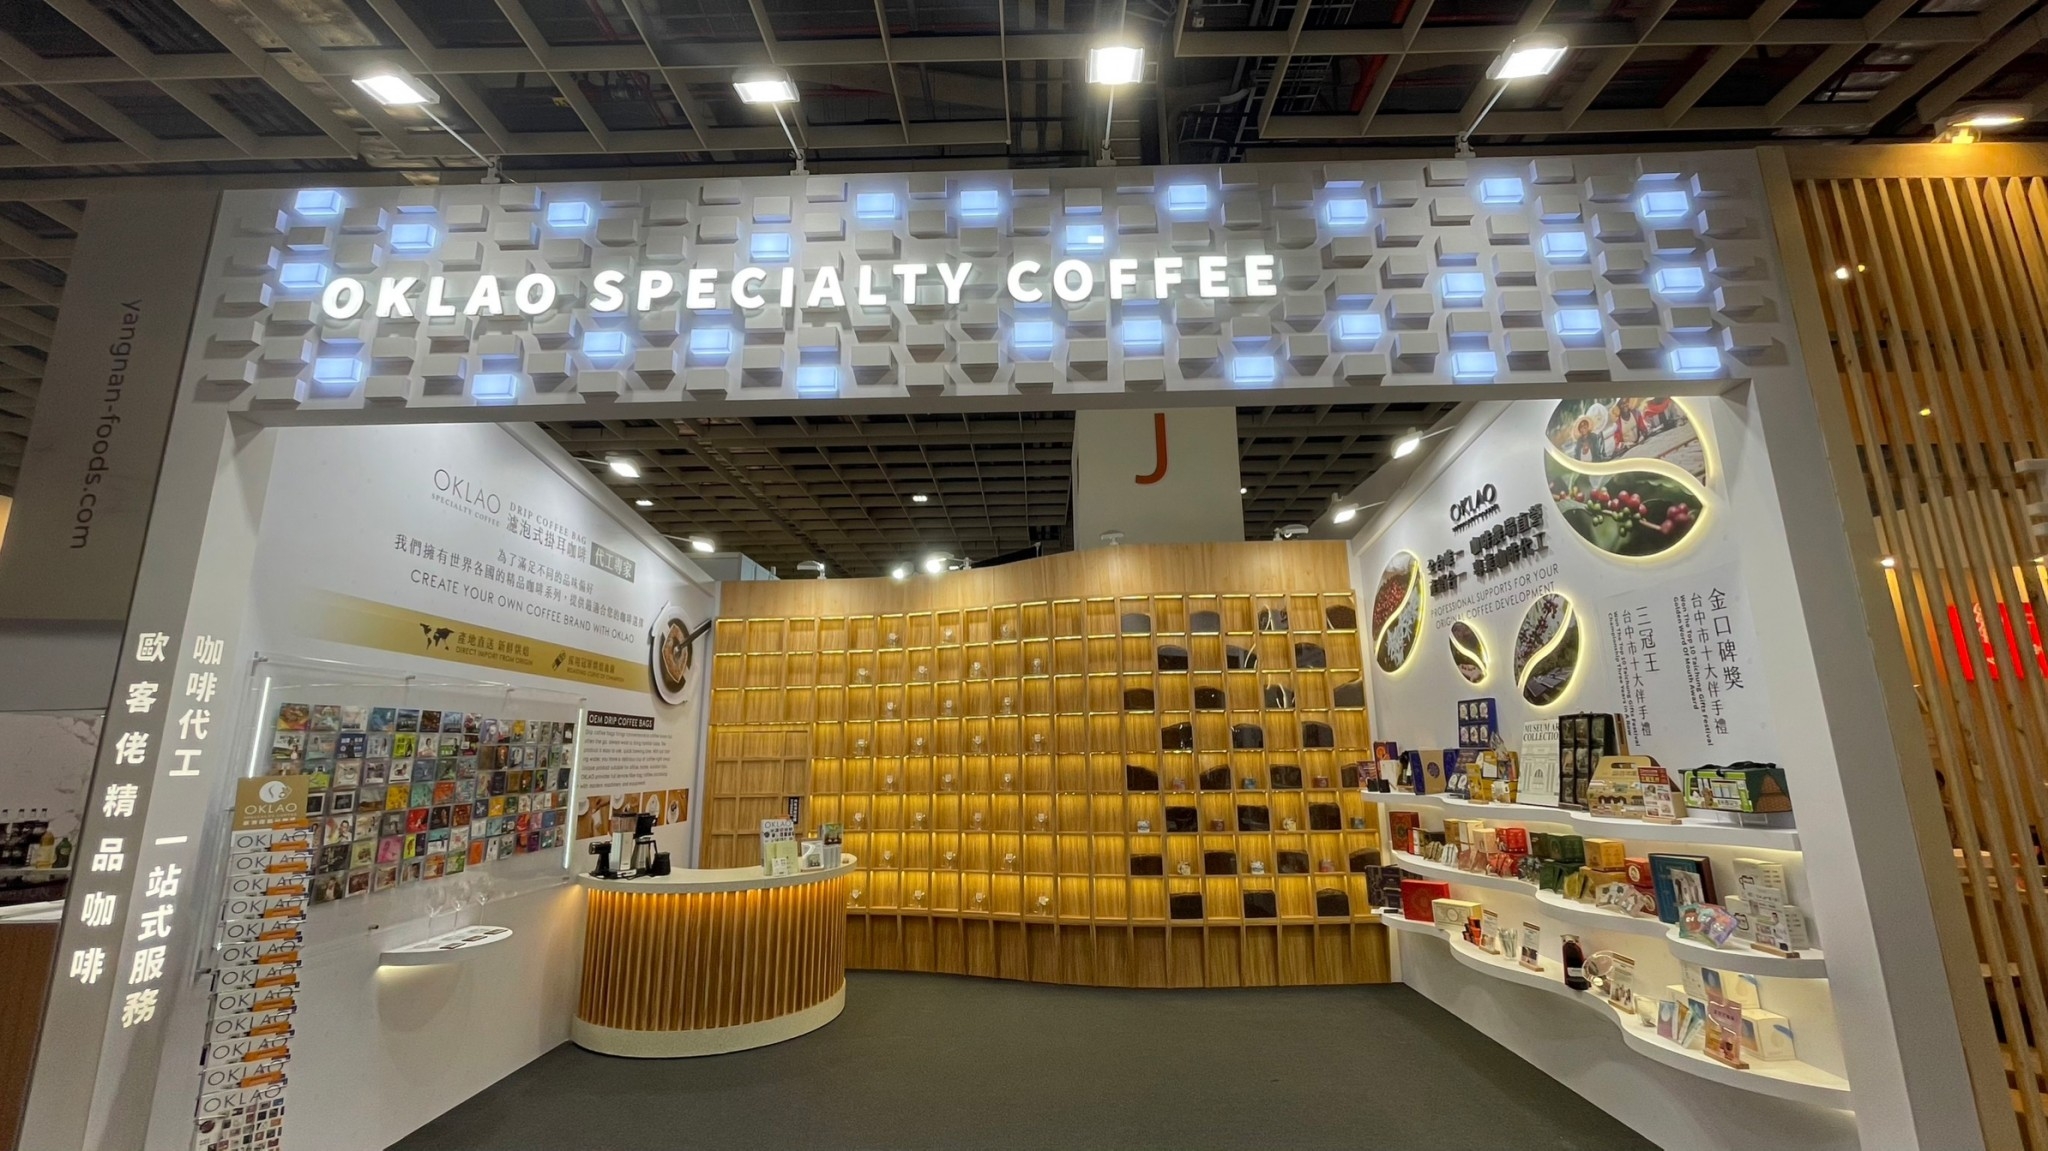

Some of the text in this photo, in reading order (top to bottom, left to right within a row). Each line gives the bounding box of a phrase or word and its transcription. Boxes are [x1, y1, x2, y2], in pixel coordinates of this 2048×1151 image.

[321, 254, 1277, 320] OKLAO SPECIALTY COFFEE
[69, 298, 143, 551] yangnan-foods.com
[1135, 412, 1168, 485] J
[431, 492, 501, 528] SPECIALTY COFFEE
[434, 469, 501, 514] OKLAO
[1451, 484, 1498, 522] OKLAO
[505, 512, 587, 563] 濾泡式掛耳咖啡
[509, 501, 587, 545] DRIP COFFEE BAG
[593, 548, 633, 580] 代工專家
[410, 568, 634, 645] CREATE YOUR OWN COFFEE BRAND WITH OKLAO
[1430, 562, 1560, 619] PROFESSIONAL SUPPORTS FOR YOUR
[1466, 603, 1494, 620] COFFEE
[1495, 582, 1556, 609] DEVELOPMENT
[1679, 594, 1687, 612] Won
[1608, 612, 1620, 663] Championship
[1635, 606, 1661, 673] 三冠王
[1673, 596, 1699, 710] Golden Word Of Mouth Award
[1689, 645, 1696, 655] 10
[1707, 587, 1745, 691] 金口碑獎
[1620, 656, 1627, 665] 10
[1622, 608, 1652, 737] 台中市十大伴手禮
[1690, 592, 1729, 736] 台中市十大伴手禮
[1692, 656, 1702, 693] Taichung
[1622, 666, 1632, 699] Taichung
[588, 714, 653, 729] OEM DRIP COFFEE BAGS
[1698, 693, 1706, 713] Gifts
[1522, 731, 1559, 742] COLLECTIO
[1524, 722, 1550, 733] MUSEUM
[1631, 718, 1641, 747] Festival
[1702, 714, 1714, 747] Festival
[69, 630, 170, 986] 歐客佬精品咖啡
[244, 802, 298, 815] OKLAO
[764, 820, 792, 829] OKLAO
[122, 632, 225, 1029] 咖啡代工 一站式服務
[203, 1085, 280, 1113] OKLAO
